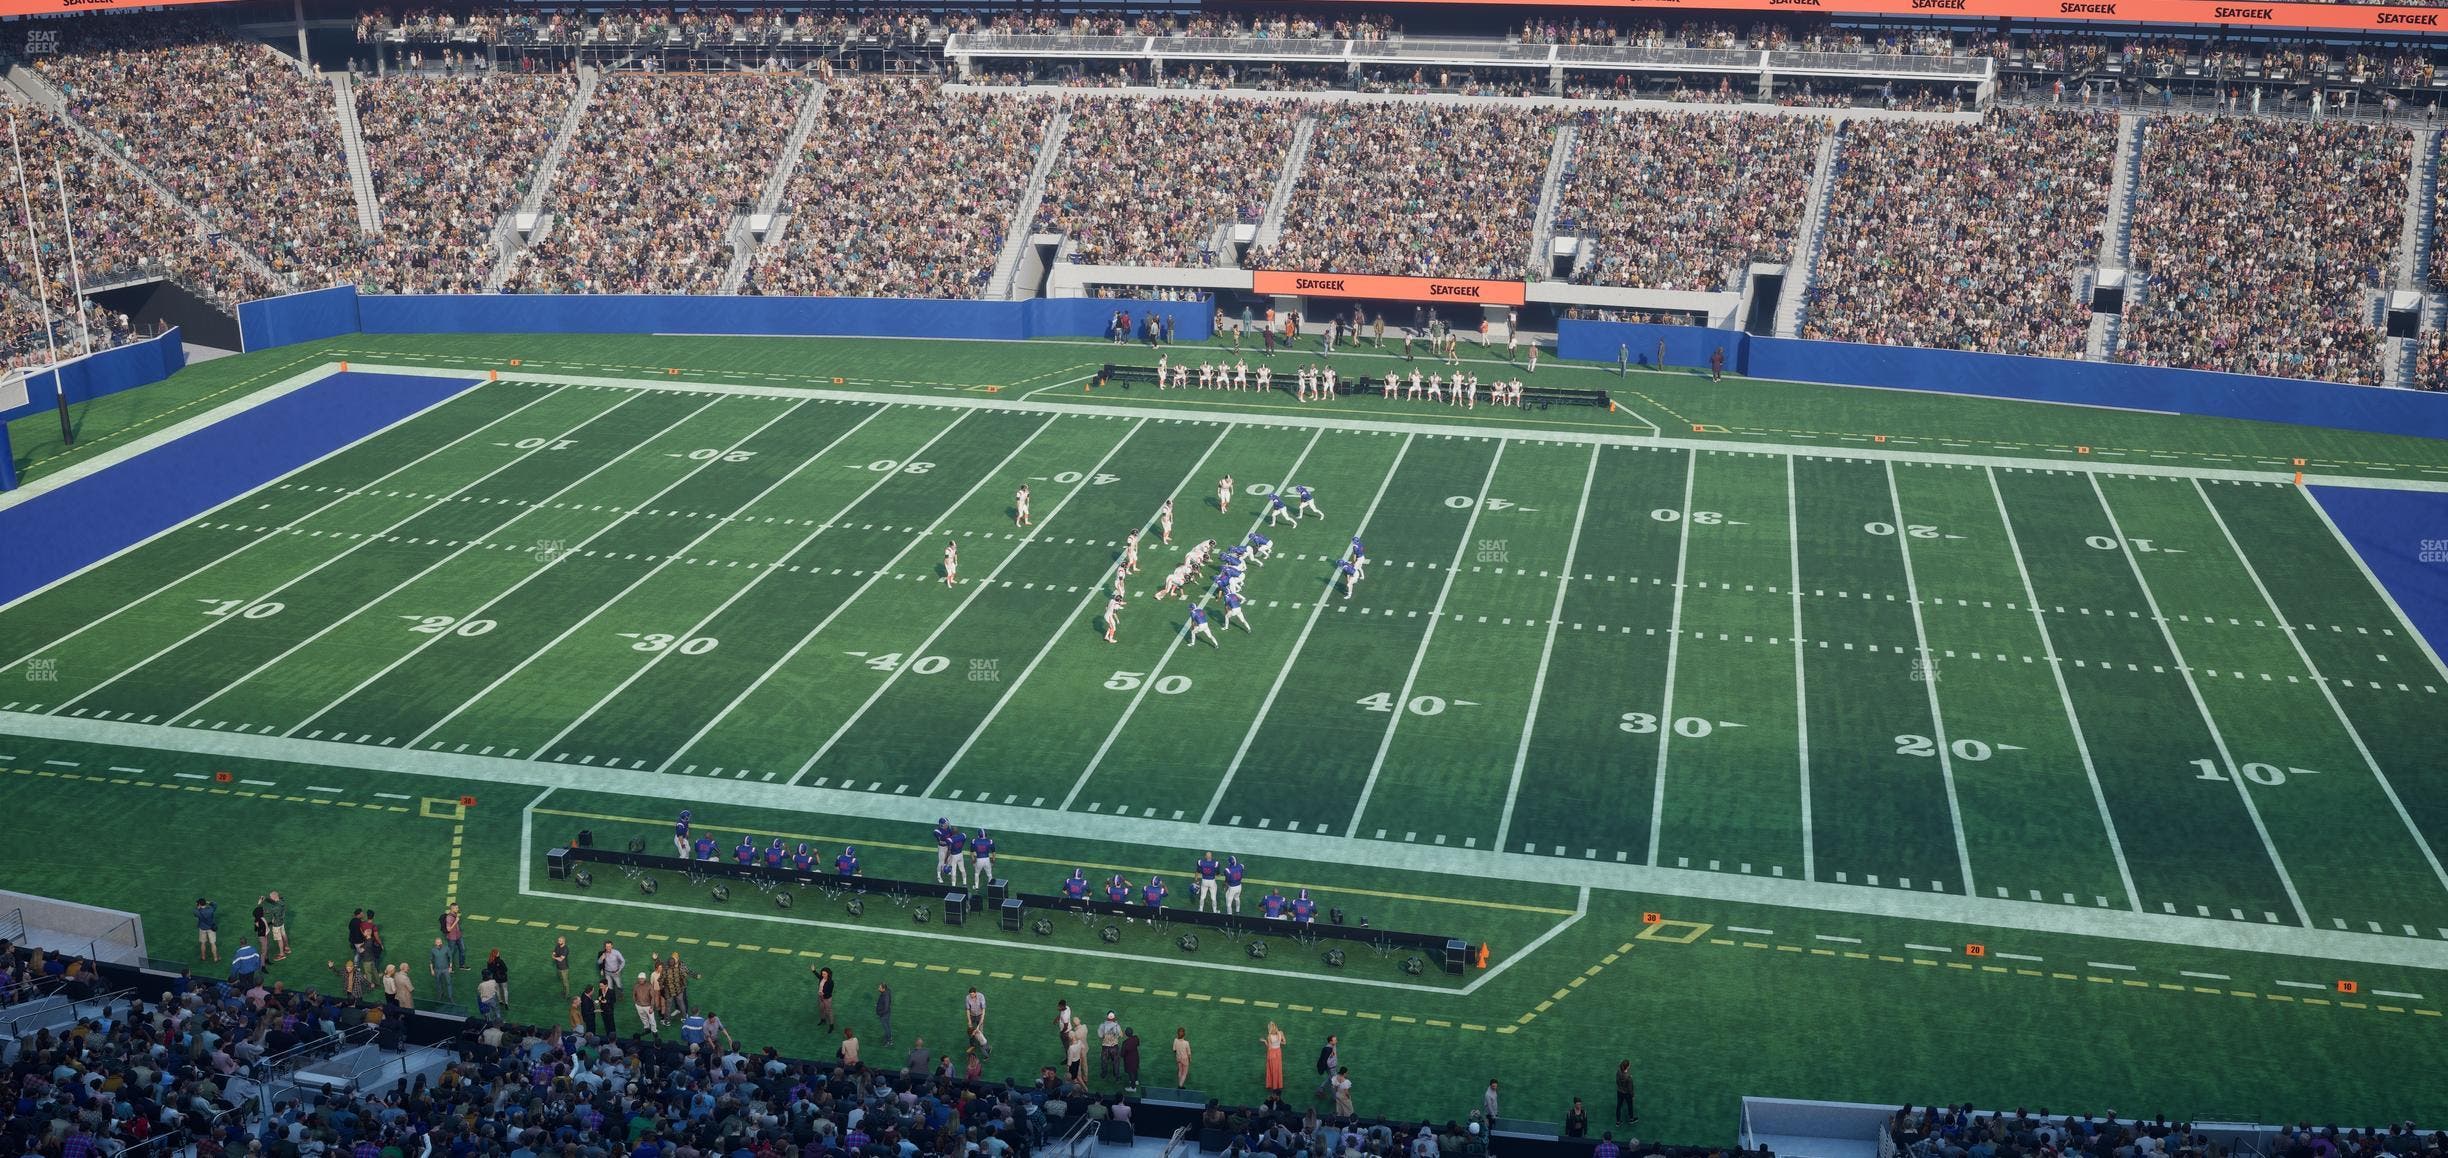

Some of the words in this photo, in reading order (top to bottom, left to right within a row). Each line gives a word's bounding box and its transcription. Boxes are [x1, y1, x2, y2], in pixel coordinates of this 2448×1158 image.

[1912, 0, 1966, 9] SEATGEEK
[2060, 2, 2116, 14] SEATGEEK
[2214, 7, 2272, 19] SEATGEEK
[2377, 13, 2438, 25] SEATGEEK
[1296, 278, 1344, 291] SEATGEEK
[1430, 284, 1480, 297] SEATGEEK
[514, 438, 579, 450] 10
[689, 448, 757, 462] 20
[868, 460, 936, 474] 30
[1054, 470, 1122, 485] 40
[1444, 496, 1515, 510] 40
[1651, 508, 1723, 526] 30
[1864, 521, 1938, 538] 20
[2085, 535, 2158, 552] 10
[205, 600, 286, 619] 10
[408, 615, 498, 637] 20
[632, 634, 720, 655] 30
[865, 652, 951, 676] 40
[1104, 671, 1192, 694] 50
[1356, 692, 1446, 716] 40
[1619, 713, 1712, 739] 30
[1894, 735, 1994, 762] 20
[2190, 758, 2287, 786] 10
